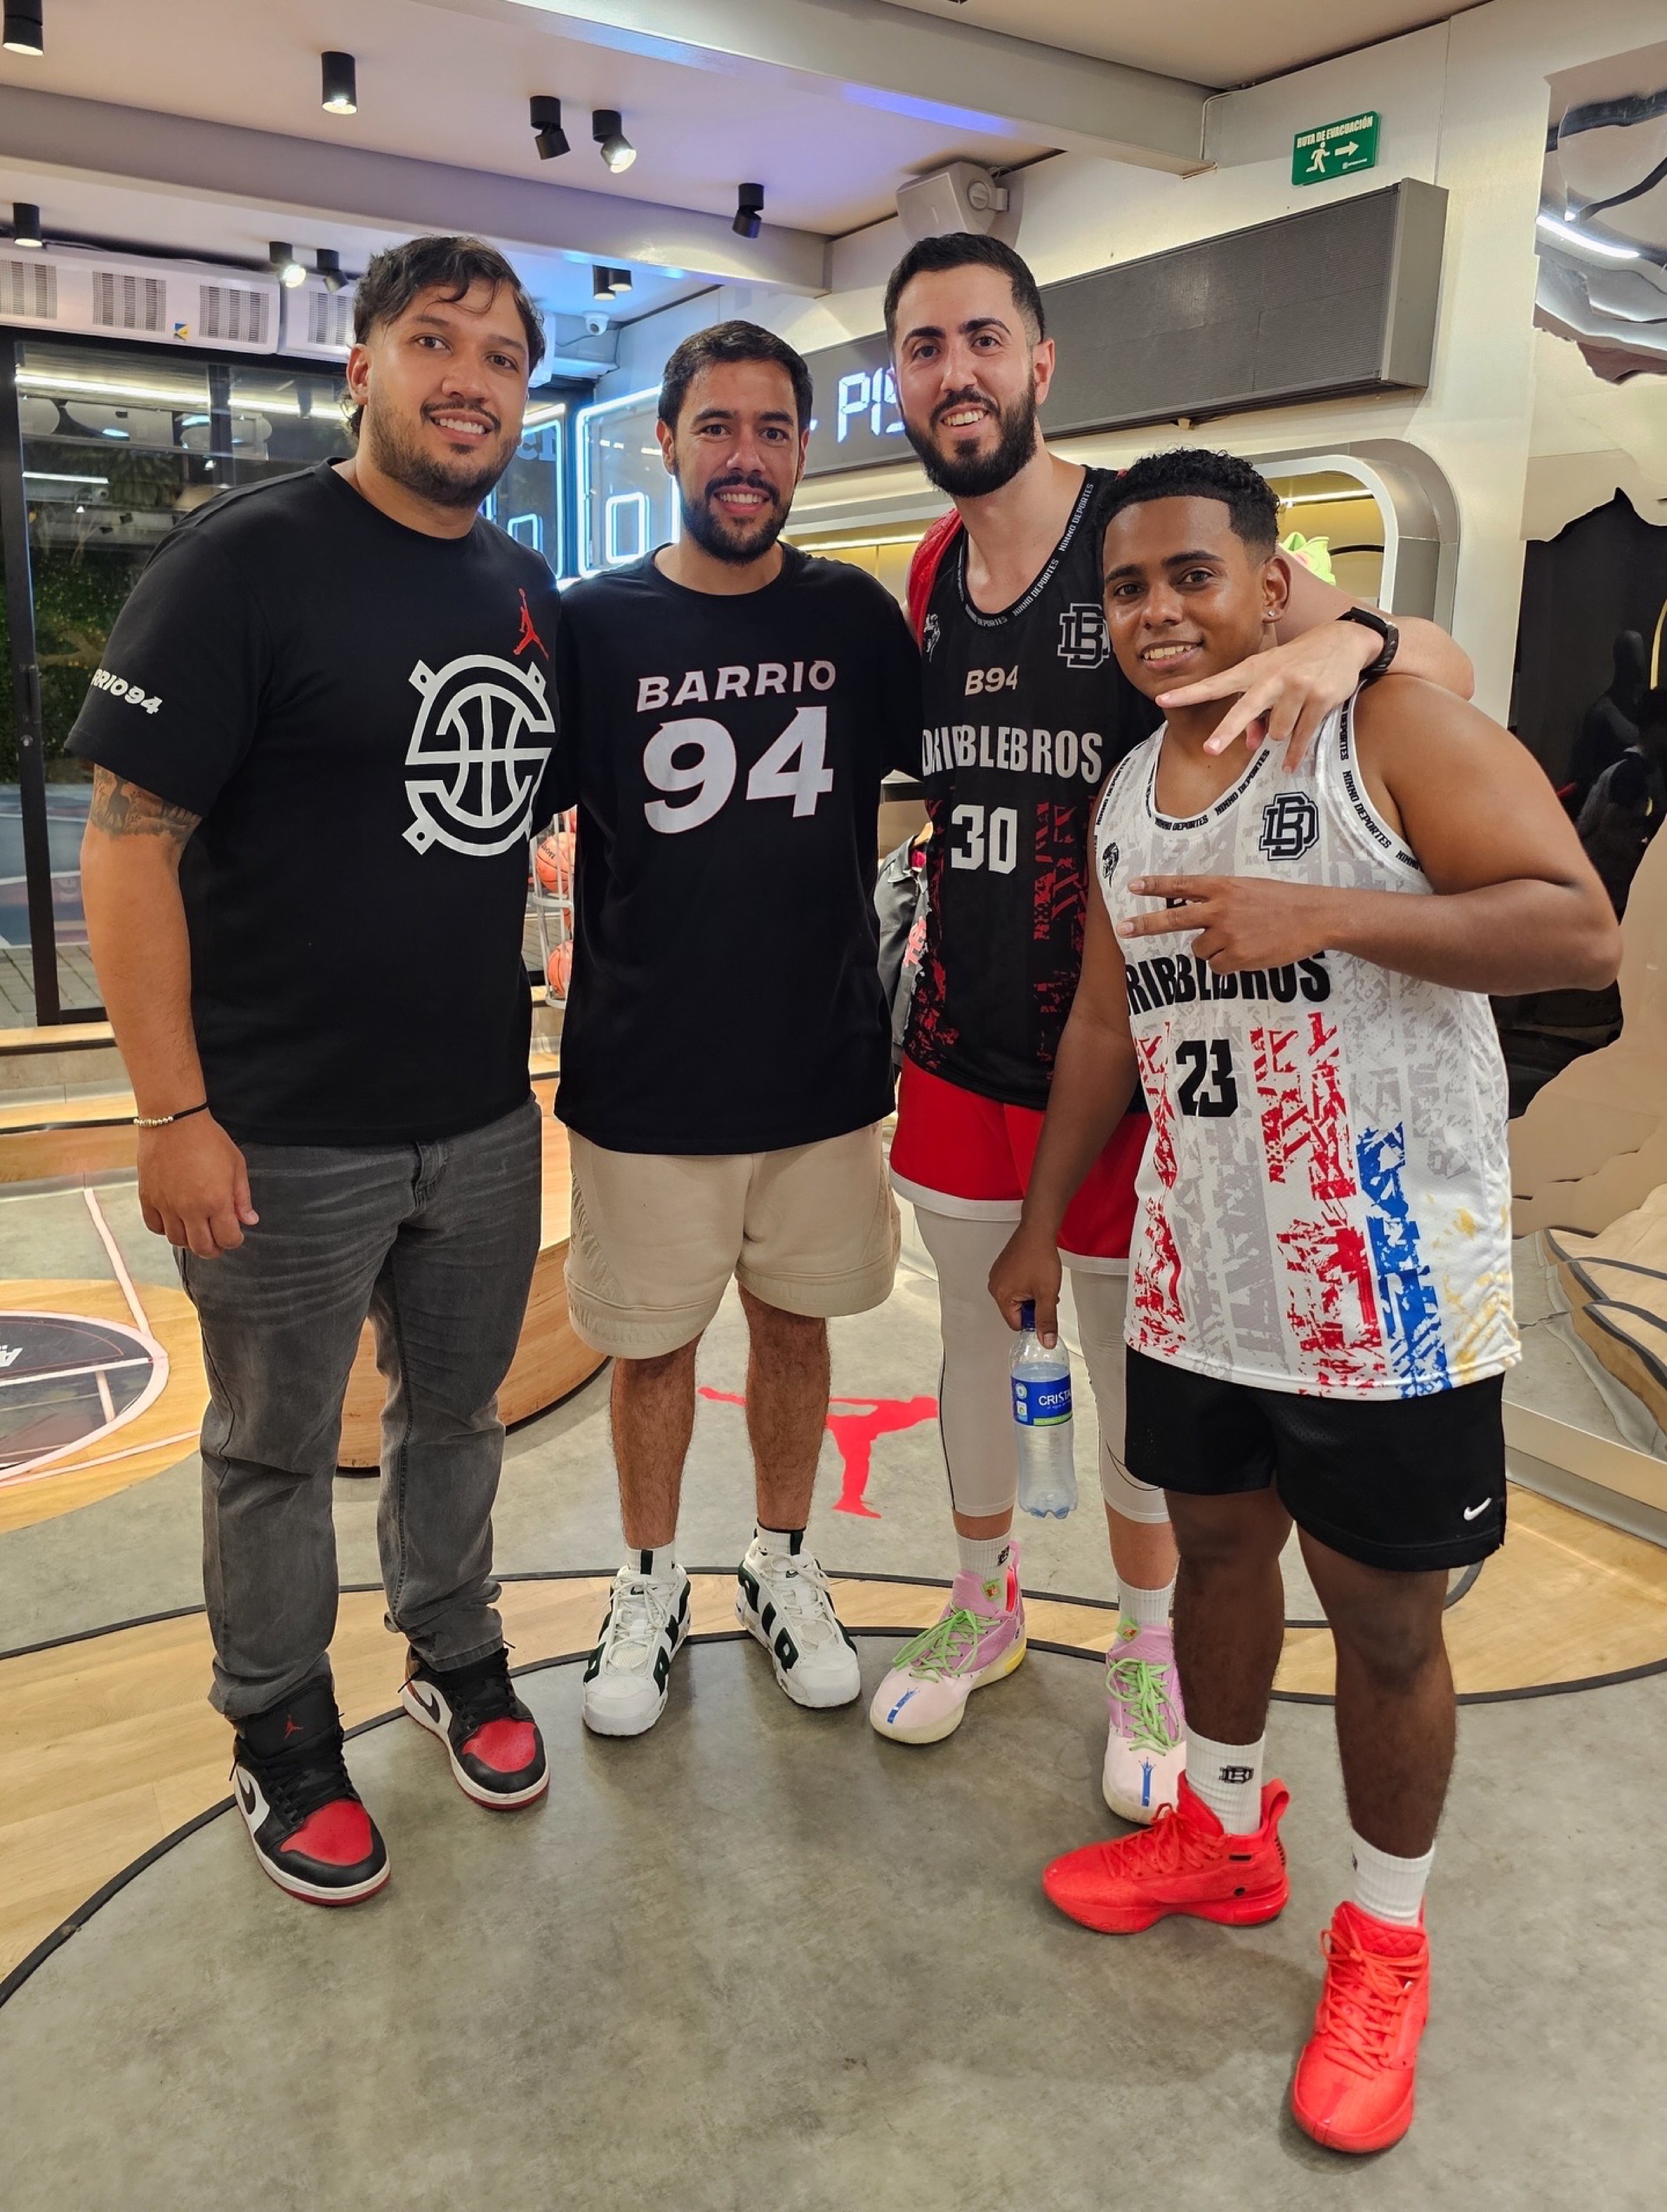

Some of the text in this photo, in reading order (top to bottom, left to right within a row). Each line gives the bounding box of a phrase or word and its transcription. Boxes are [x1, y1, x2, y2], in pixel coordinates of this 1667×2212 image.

[1296, 115, 1373, 149] RUTA DE EVACUACIÓN
[1072, 483, 1095, 524] DEPORTES
[1031, 558, 1059, 598] DEPORTES
[636, 660, 836, 713] BARRIO
[964, 665, 1019, 697] B94
[643, 706, 834, 834] 94
[1237, 749, 1270, 795] DEPORTES
[950, 804, 1018, 875] 30
[1354, 803, 1393, 849] DEPORTES
[1175, 1039, 1238, 1118] 23
